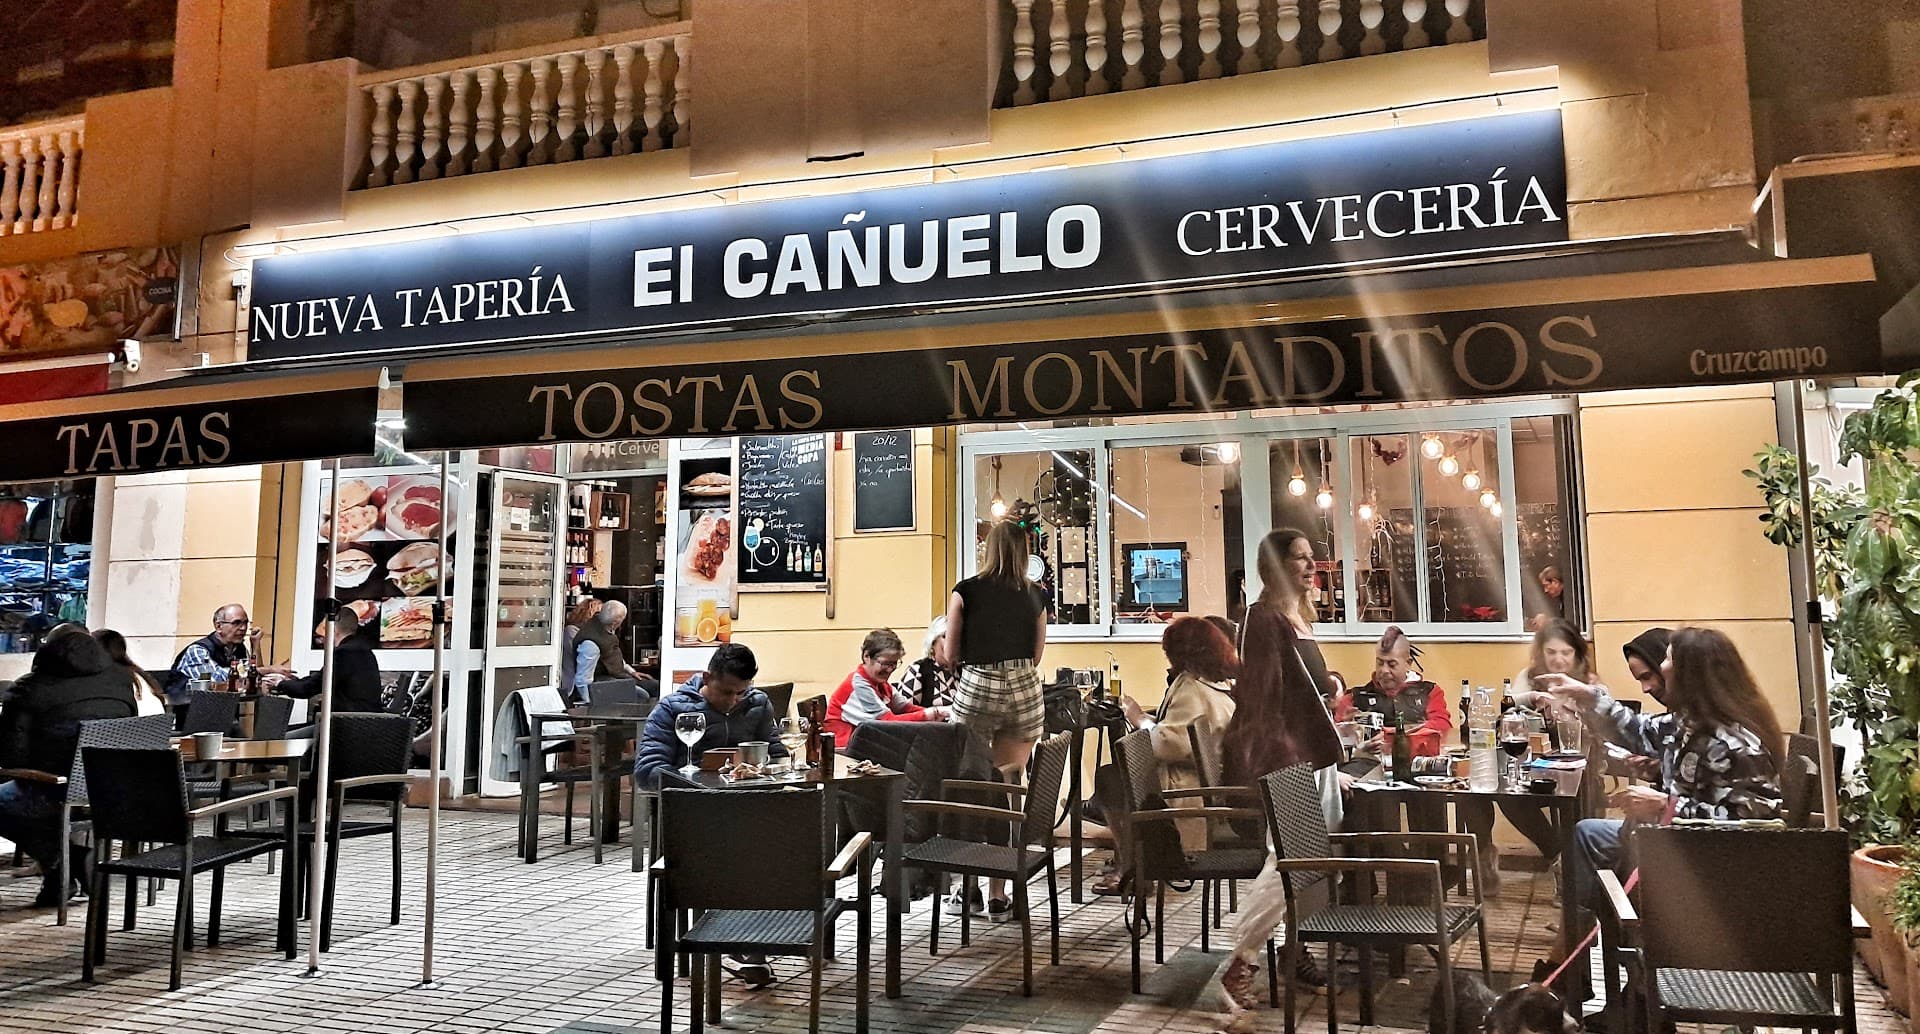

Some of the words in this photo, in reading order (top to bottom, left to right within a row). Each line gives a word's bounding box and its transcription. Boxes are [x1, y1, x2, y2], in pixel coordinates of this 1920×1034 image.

[1176, 166, 1561, 256] CERVECERÍA
[723, 204, 1101, 299] CAÑUELO
[252, 293, 384, 342] NUEVA
[396, 265, 576, 328] TAPERÍA
[946, 315, 1603, 419] MONTADITOS
[1690, 346, 1827, 376] Cruzcampo
[528, 370, 824, 441] TOSTAS
[56, 412, 231, 474] TAPAS
[797, 439, 824, 455] MEDIA
[797, 451, 819, 465] COPA
[872, 434, 897, 446] 20/12
